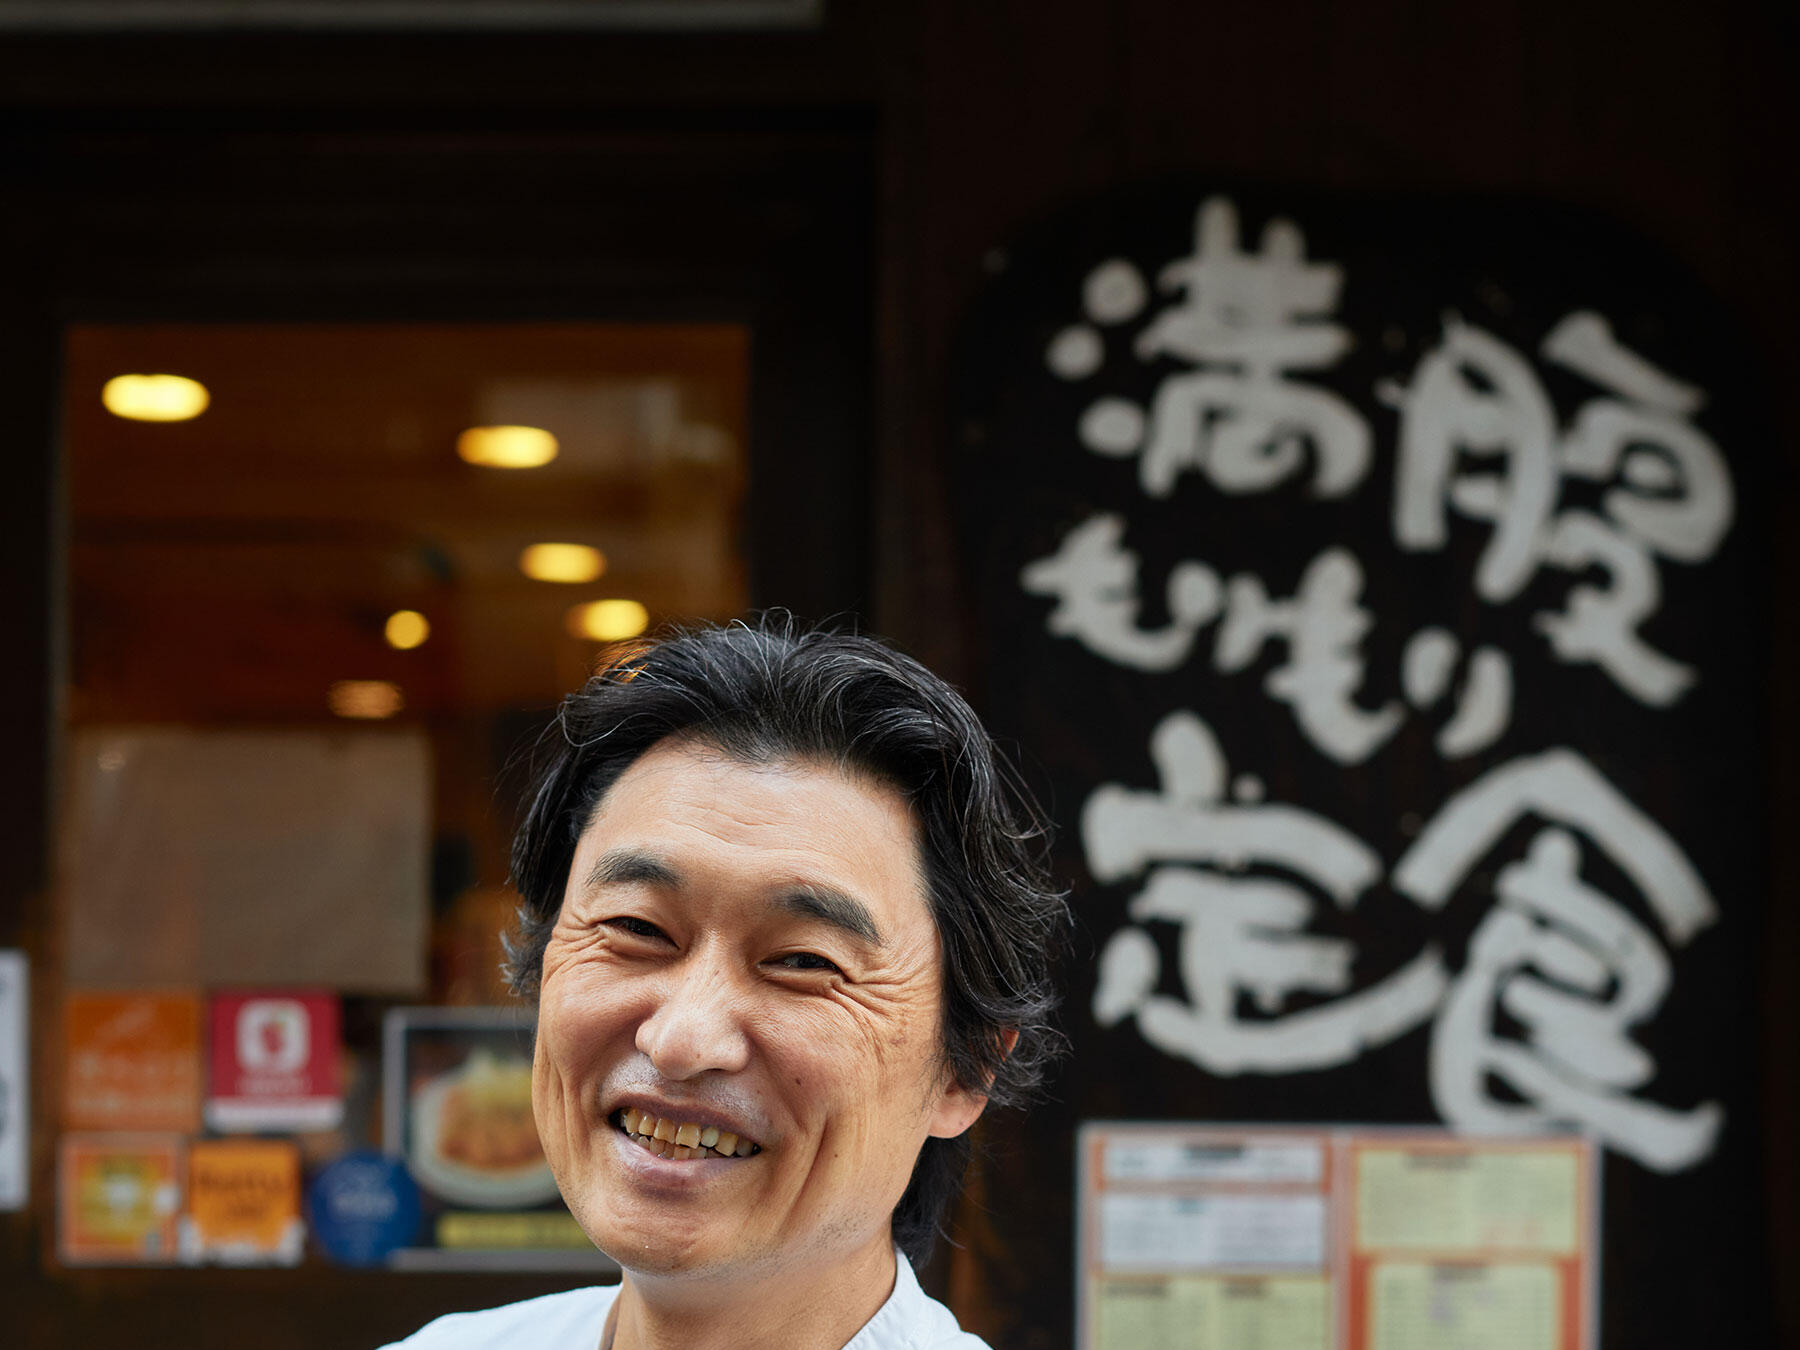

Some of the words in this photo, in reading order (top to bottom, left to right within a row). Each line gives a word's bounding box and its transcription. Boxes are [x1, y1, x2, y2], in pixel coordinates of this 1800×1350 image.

[1021, 514, 1513, 764] もりもり
[1048, 198, 1733, 707] 満腹
[1079, 712, 1722, 1174] 定食
